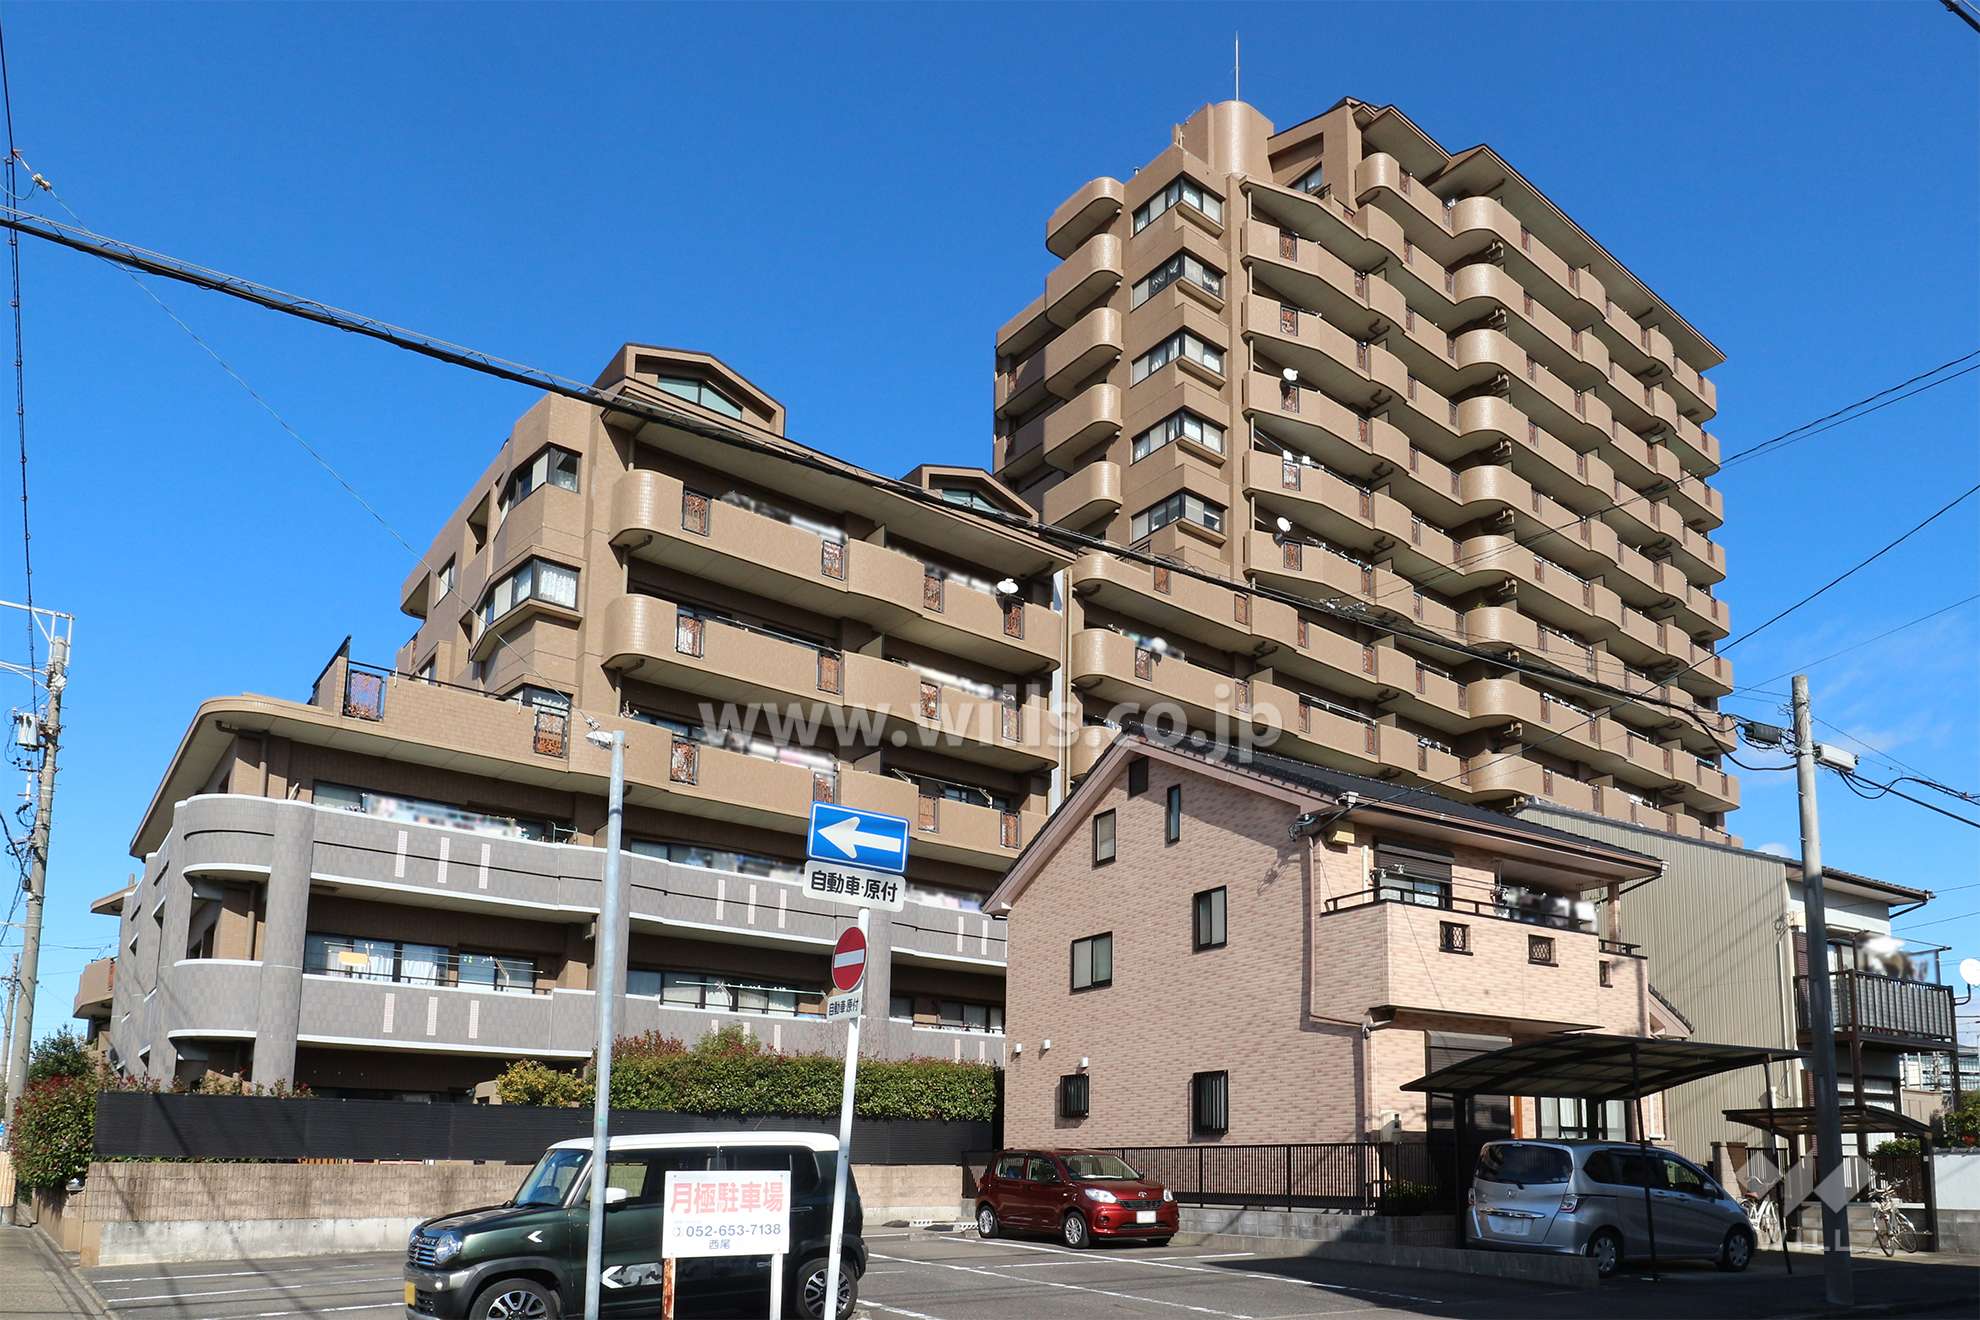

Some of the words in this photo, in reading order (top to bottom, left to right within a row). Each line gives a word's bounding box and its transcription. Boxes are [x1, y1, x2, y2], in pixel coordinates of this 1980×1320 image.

[671, 1182, 784, 1214] 月極駐車場
[686, 1224, 781, 1238] 052-653-7138
[709, 1239, 731, 1250] 西尾
